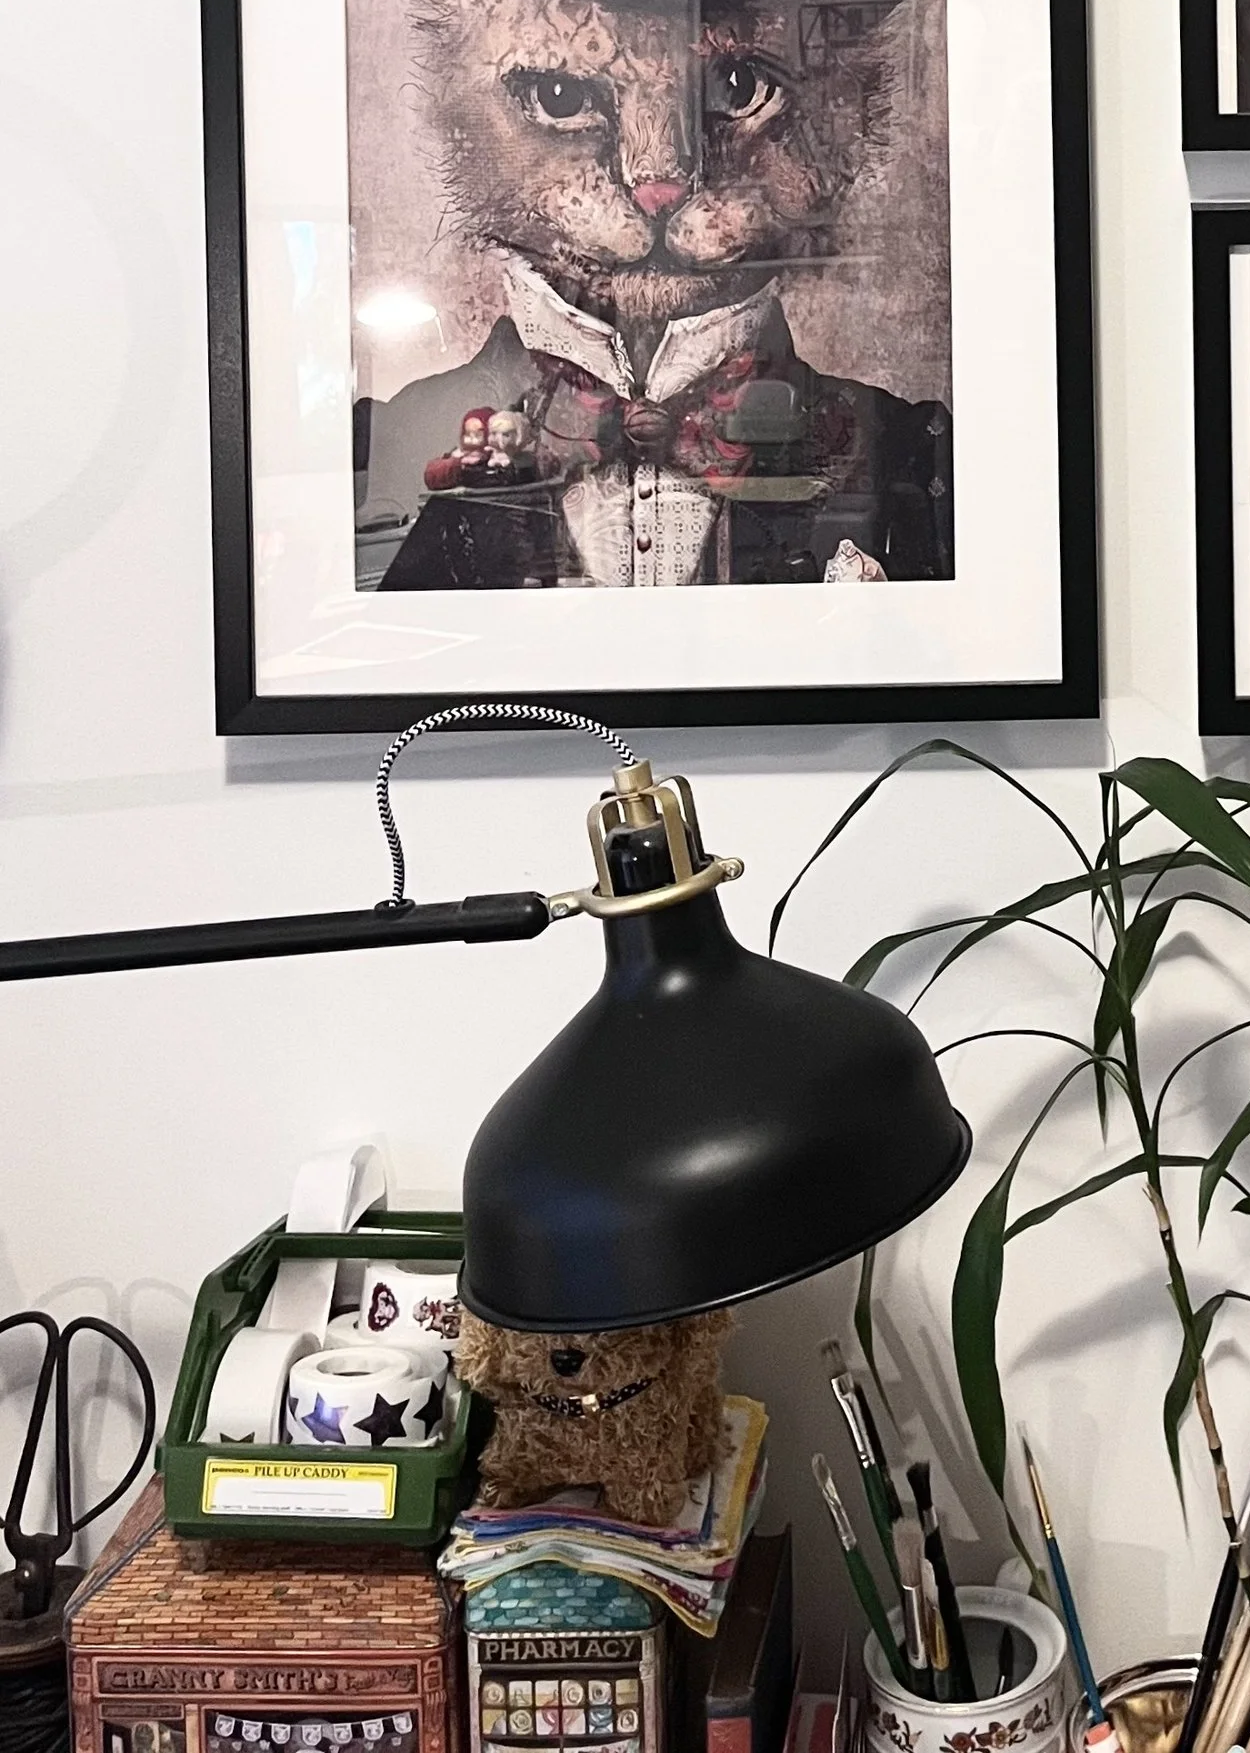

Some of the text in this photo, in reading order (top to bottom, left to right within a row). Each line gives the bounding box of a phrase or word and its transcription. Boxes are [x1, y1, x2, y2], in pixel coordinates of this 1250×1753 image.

[254, 1465, 281, 1477] PILE
[284, 1466, 300, 1478] UP
[303, 1467, 350, 1479] CADDY
[484, 1639, 636, 1661] PHARMACY
[234, 1668, 339, 1691] SMITH'S
